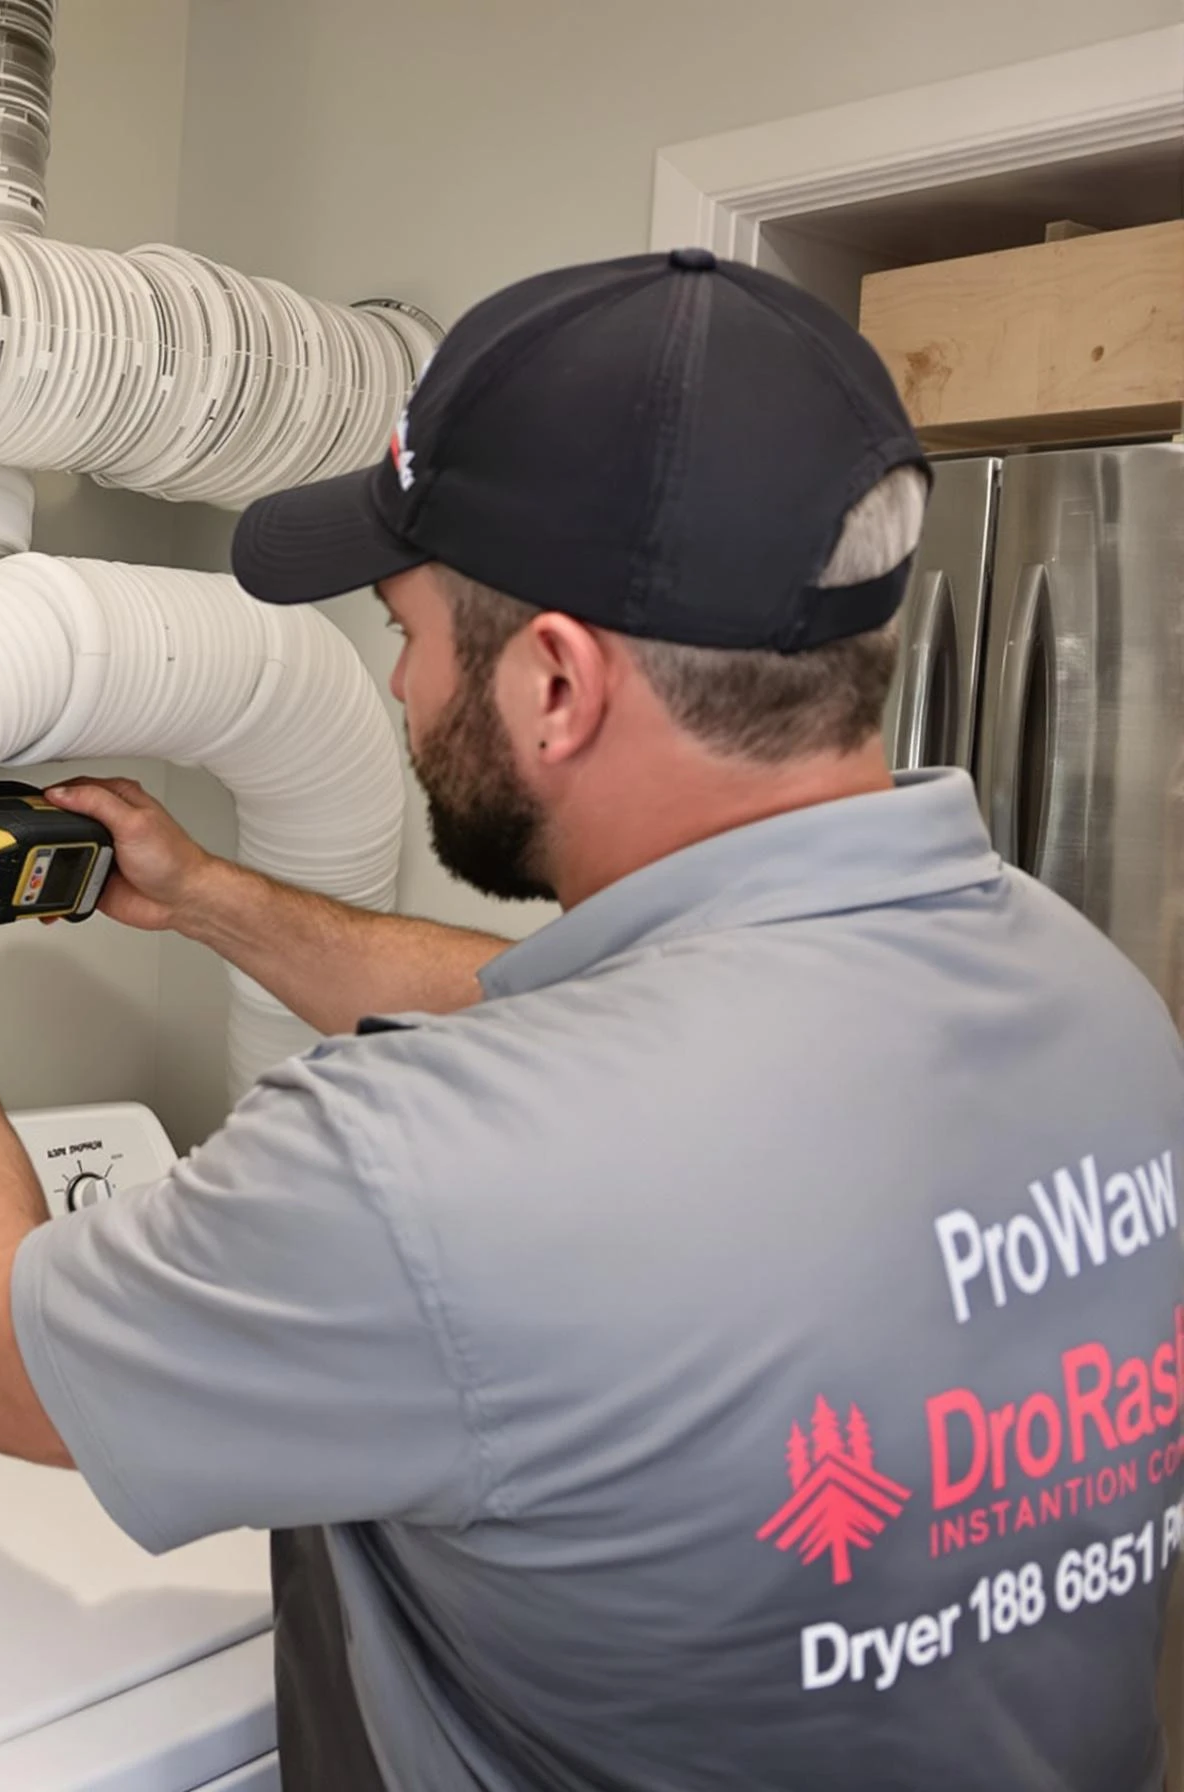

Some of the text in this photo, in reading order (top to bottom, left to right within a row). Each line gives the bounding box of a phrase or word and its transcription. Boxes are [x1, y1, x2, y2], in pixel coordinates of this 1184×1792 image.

[929, 1463, 1138, 1559] INSTANTION
[801, 1604, 961, 1690] Dryer
[969, 1563, 1045, 1642] 188
[1055, 1520, 1154, 1612] 6851
